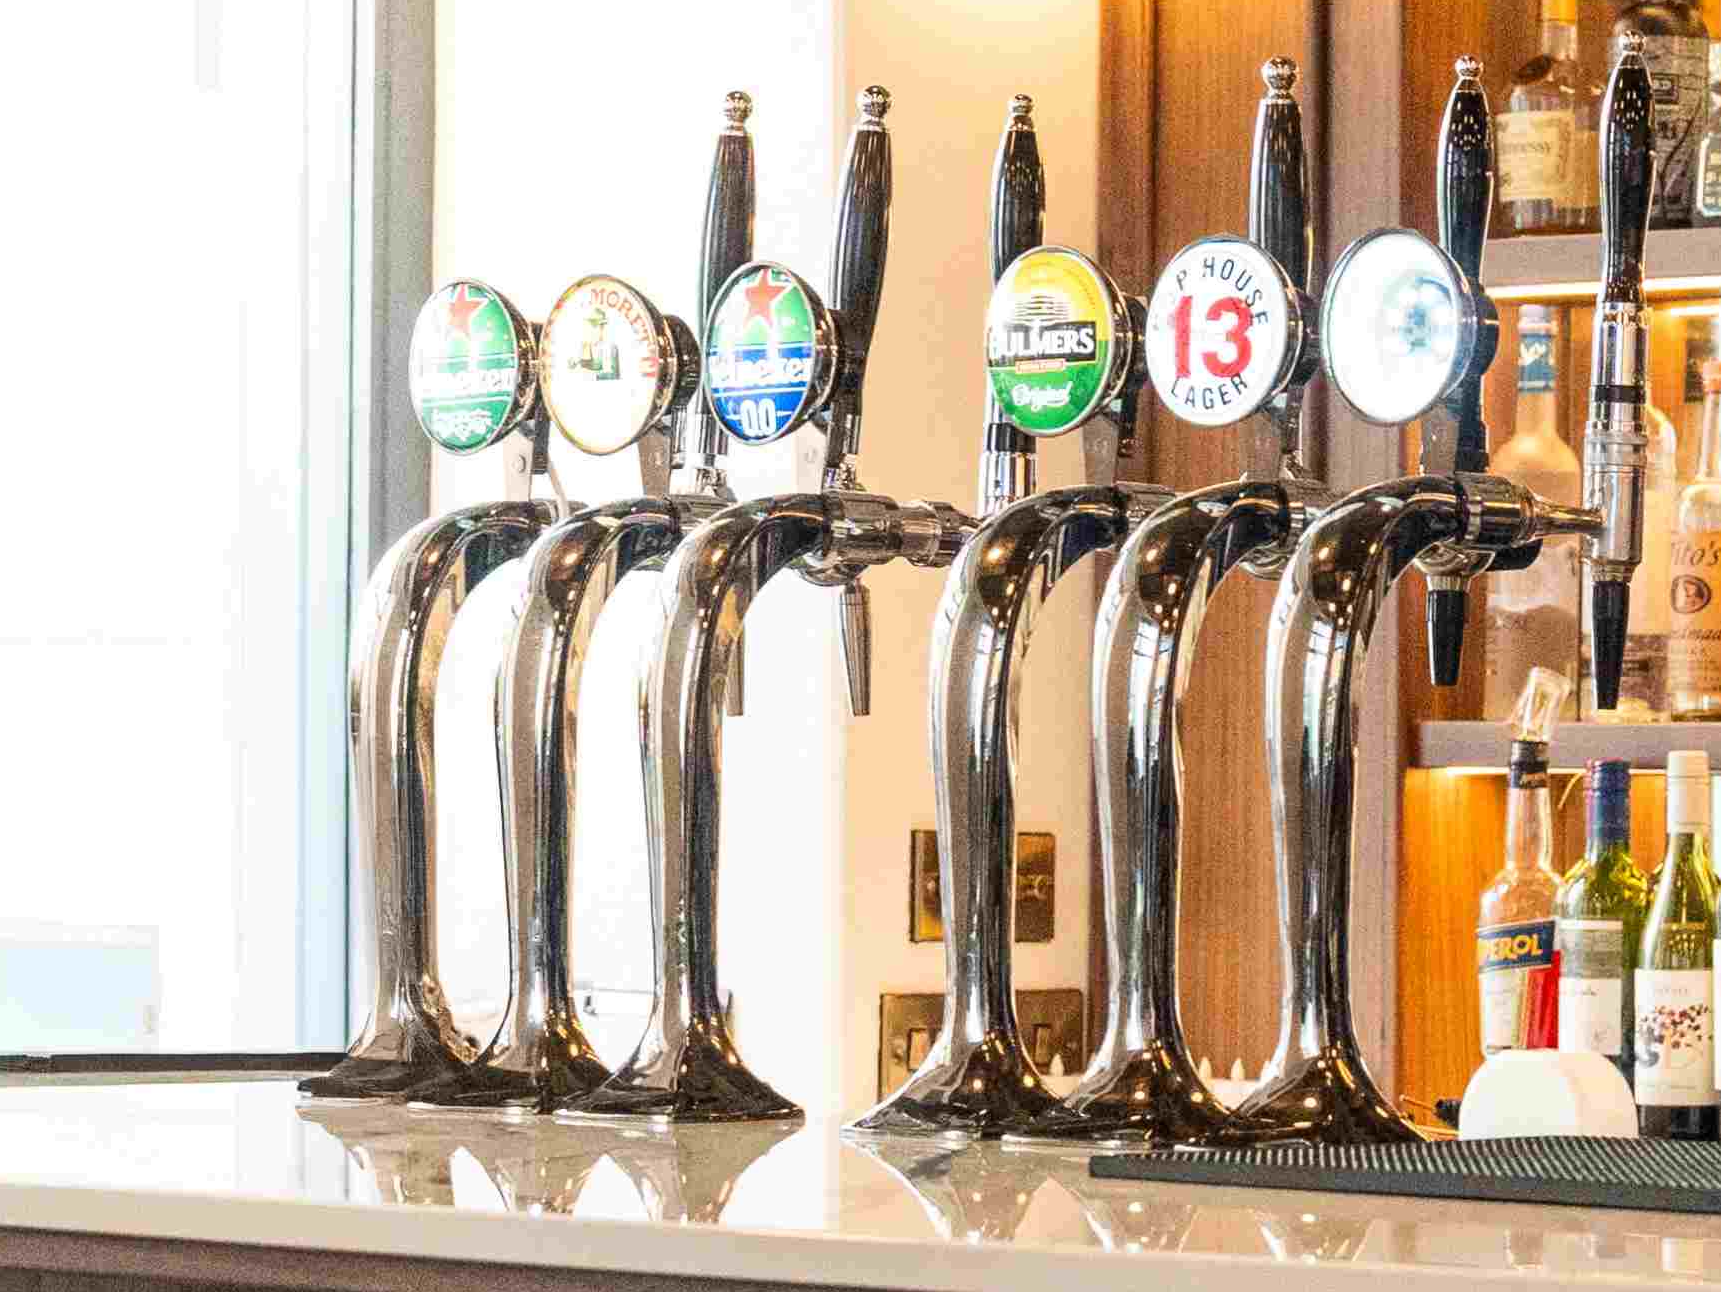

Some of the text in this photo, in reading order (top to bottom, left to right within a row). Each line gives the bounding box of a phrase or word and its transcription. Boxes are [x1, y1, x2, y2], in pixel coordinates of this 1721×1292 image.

[1203, 257, 1269, 325] HOUSE
[1175, 295, 1254, 378] 13
[1171, 373, 1247, 410] LAGER
[1477, 933, 1543, 961] EROL
